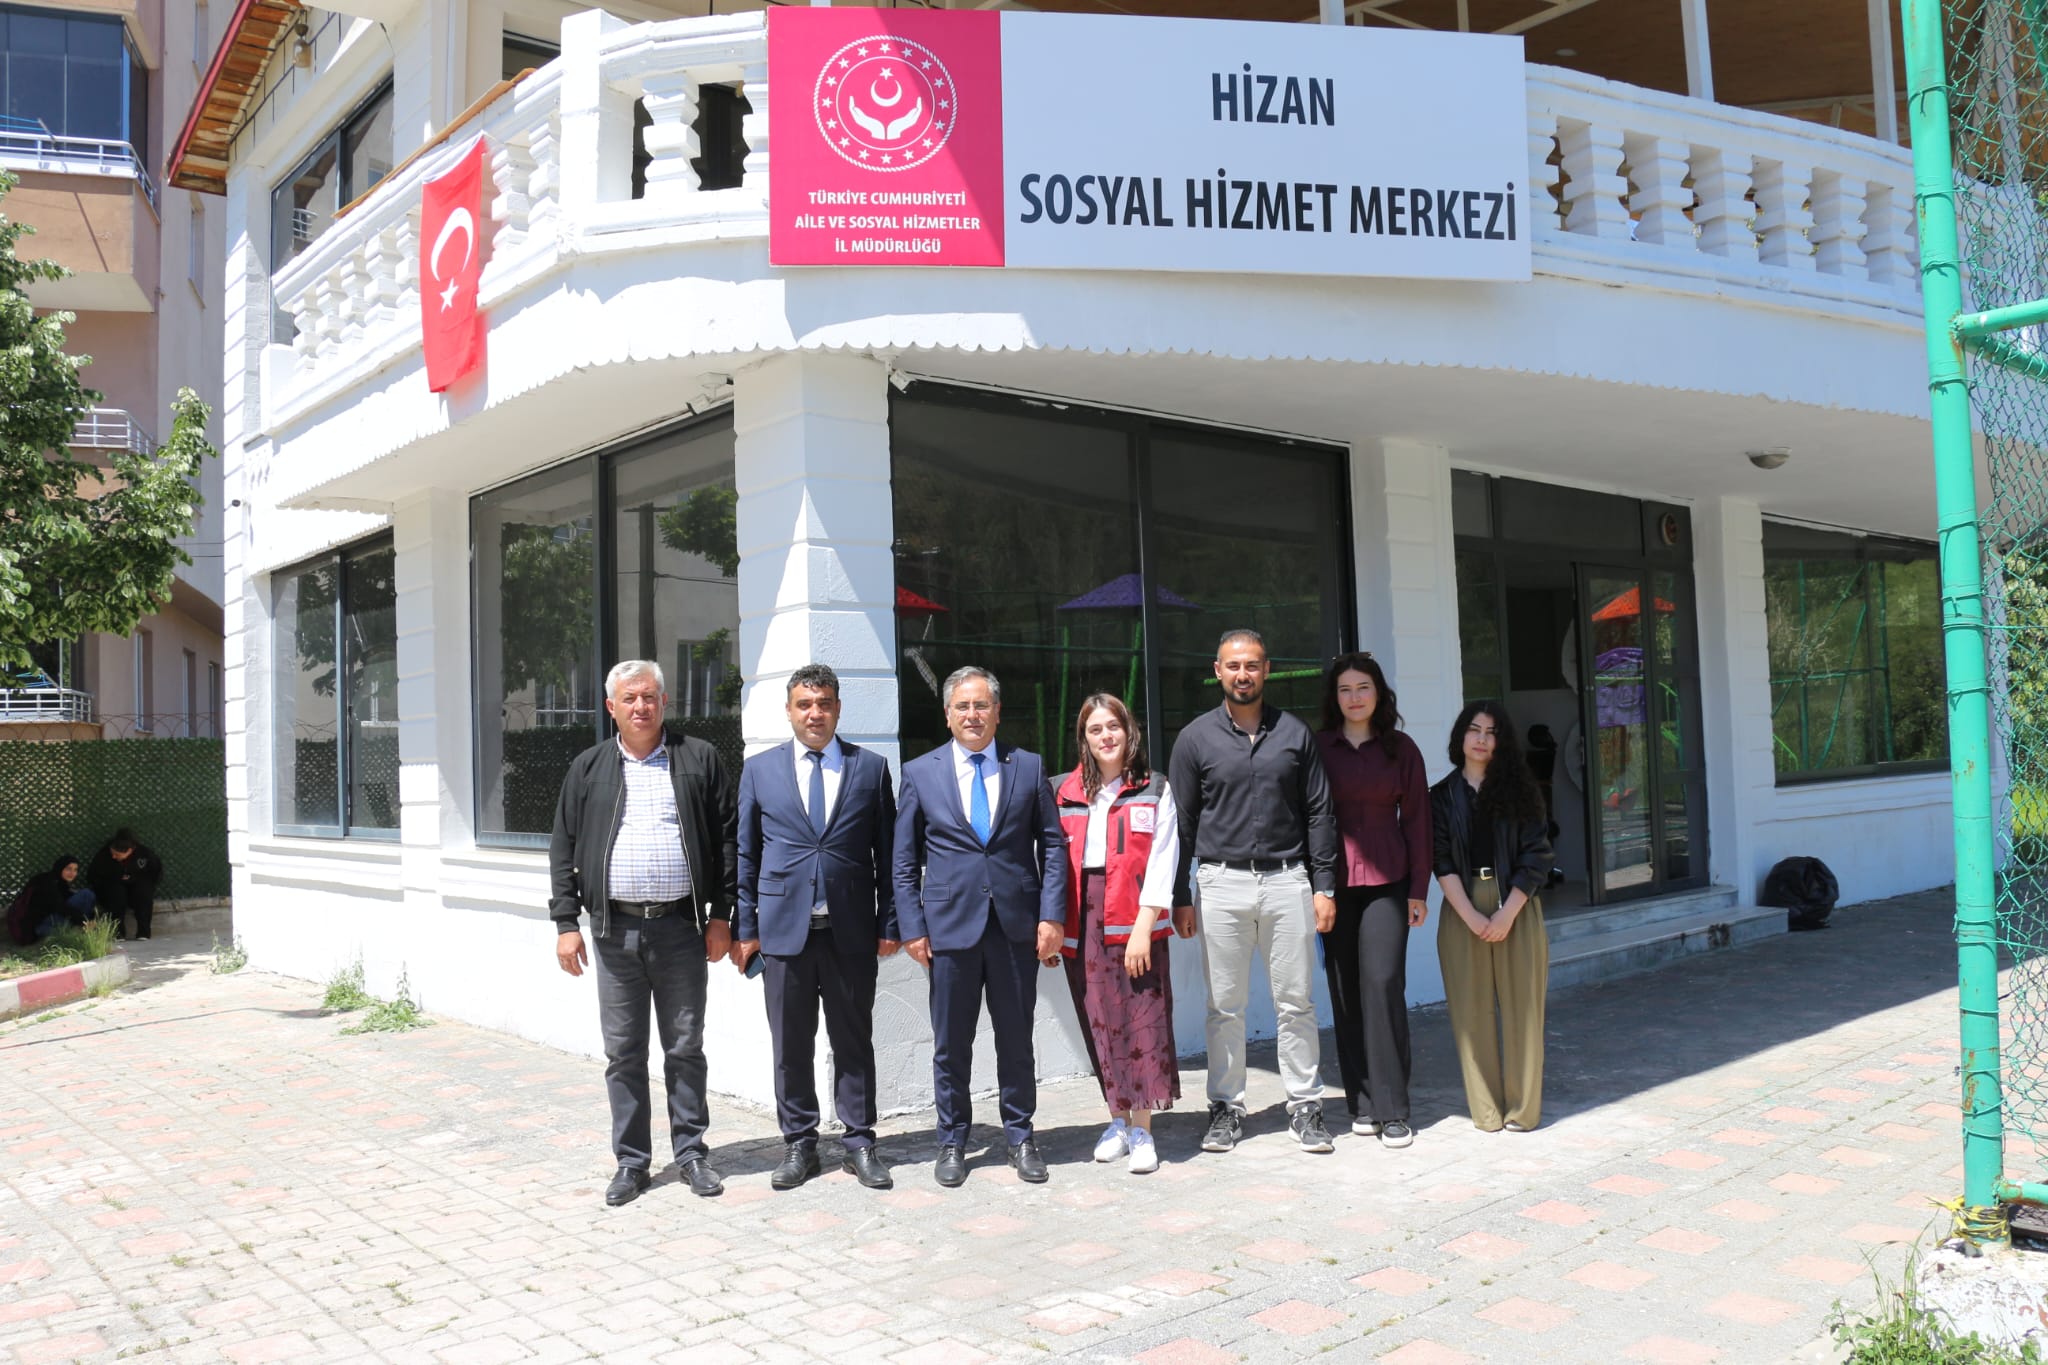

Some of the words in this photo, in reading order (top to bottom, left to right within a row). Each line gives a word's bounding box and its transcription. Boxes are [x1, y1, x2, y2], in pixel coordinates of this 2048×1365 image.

[1212, 63, 1335, 127] HİZAN
[808, 189, 868, 205] TÜRKİYE
[870, 190, 966, 206] CUMHURİYETİ
[1020, 173, 1174, 227] SOSYAL
[1187, 168, 1338, 233] HİZMET
[1350, 182, 1516, 241] MERKEZİ
[795, 213, 825, 229] AİLE
[828, 215, 846, 229] VE
[849, 215, 900, 229] SOSYAL
[903, 213, 981, 230] HİZMETLER
[835, 237, 848, 253] İL
[851, 237, 941, 254] MÜDÜRLÜĞÜ
